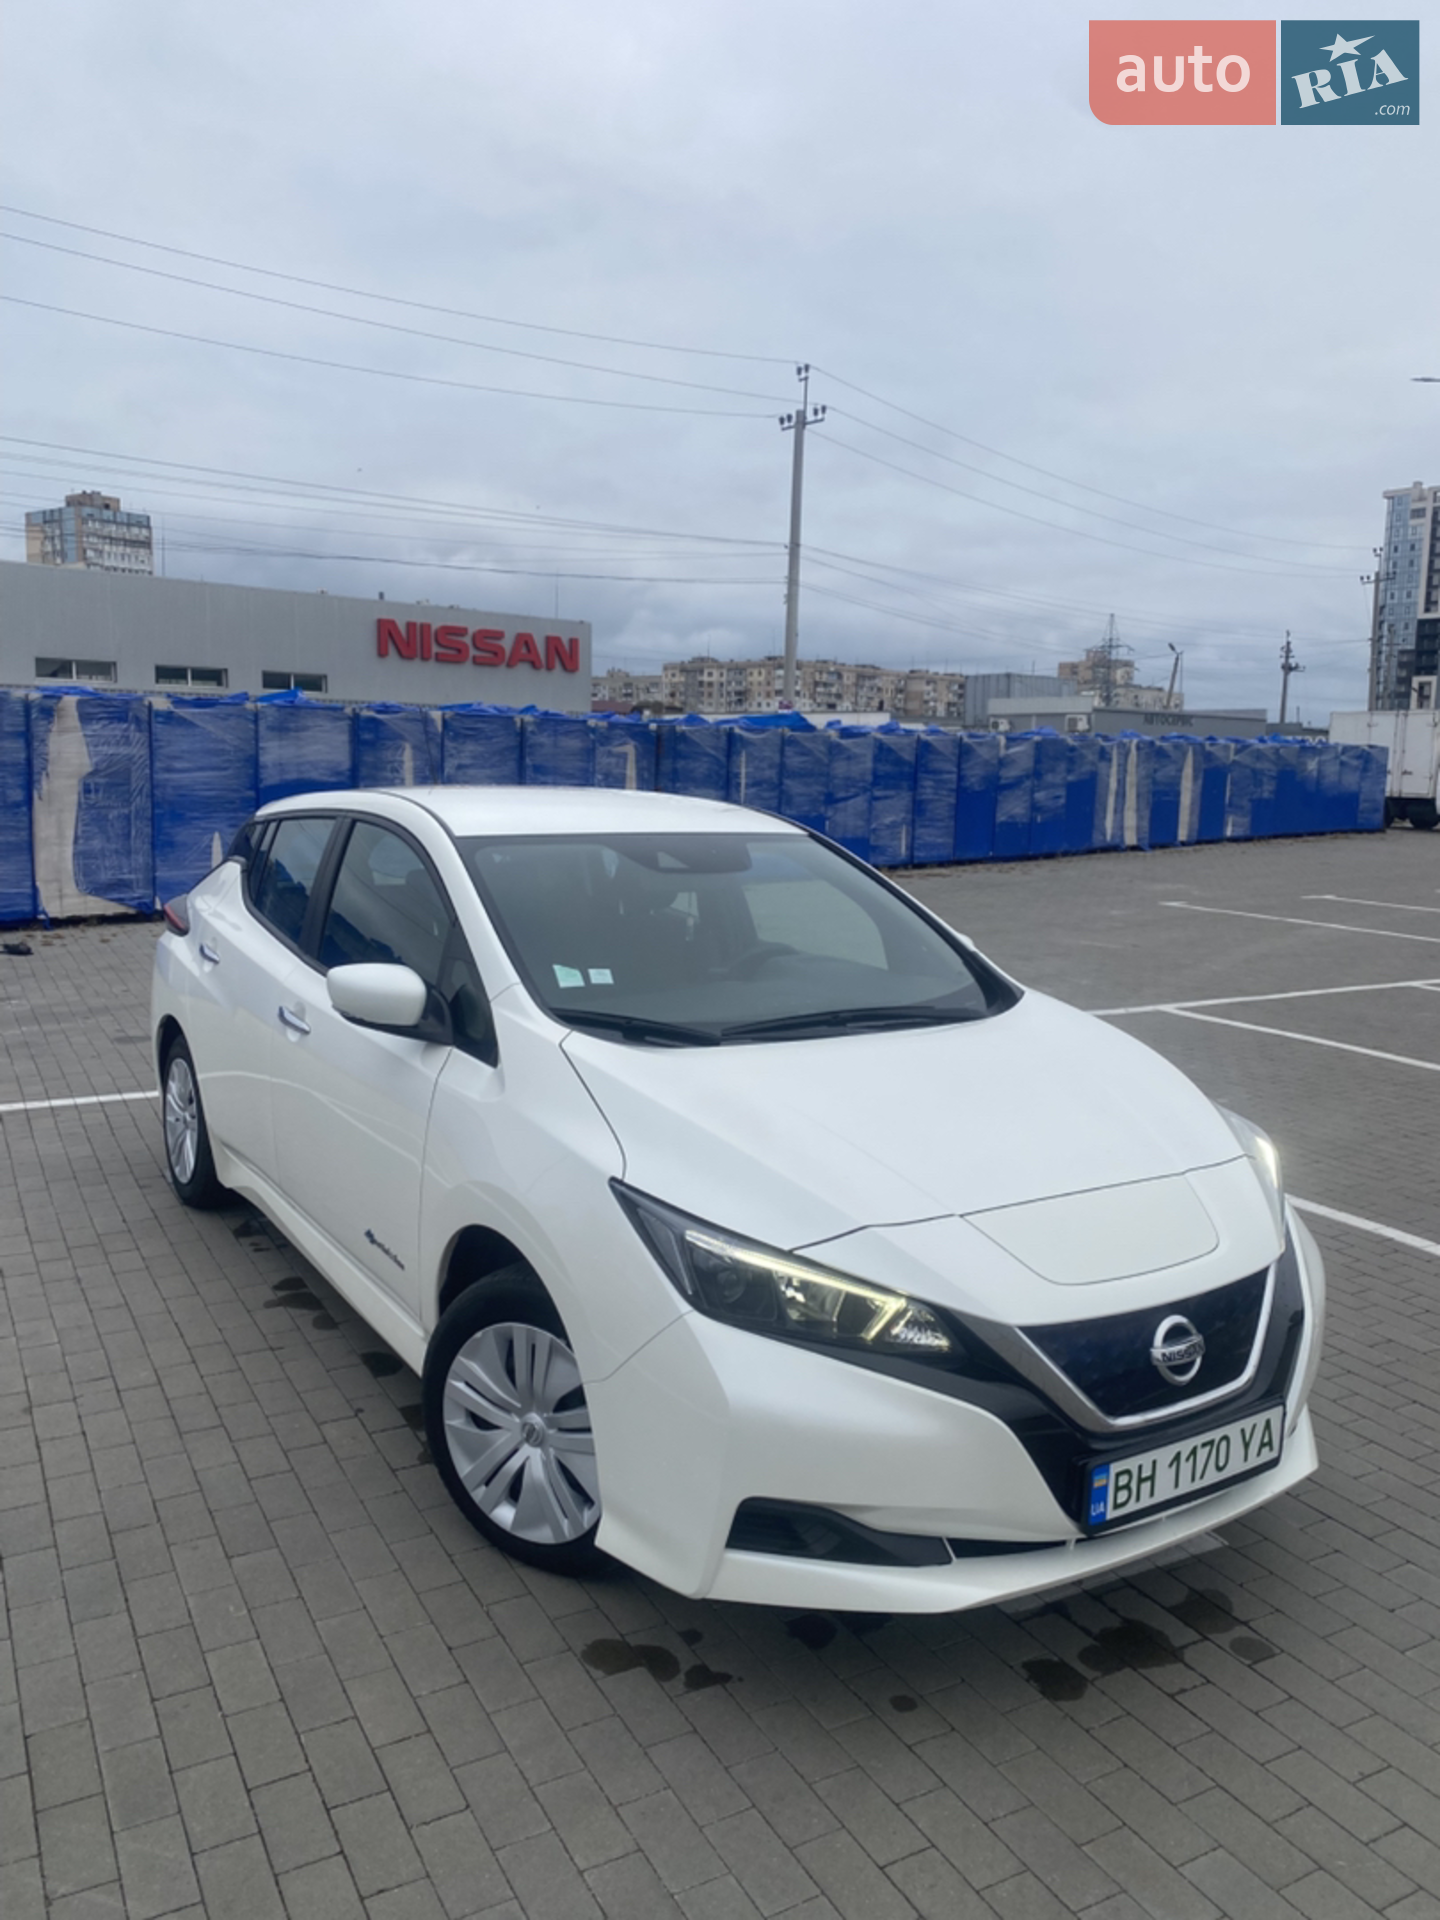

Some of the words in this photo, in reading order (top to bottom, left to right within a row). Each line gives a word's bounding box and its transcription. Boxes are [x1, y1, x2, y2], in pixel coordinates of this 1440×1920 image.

[376, 618, 580, 673] NISSAN
[1112, 1459, 1157, 1511] BH
[1168, 1434, 1231, 1490] 1170
[1240, 1417, 1274, 1463] YA
